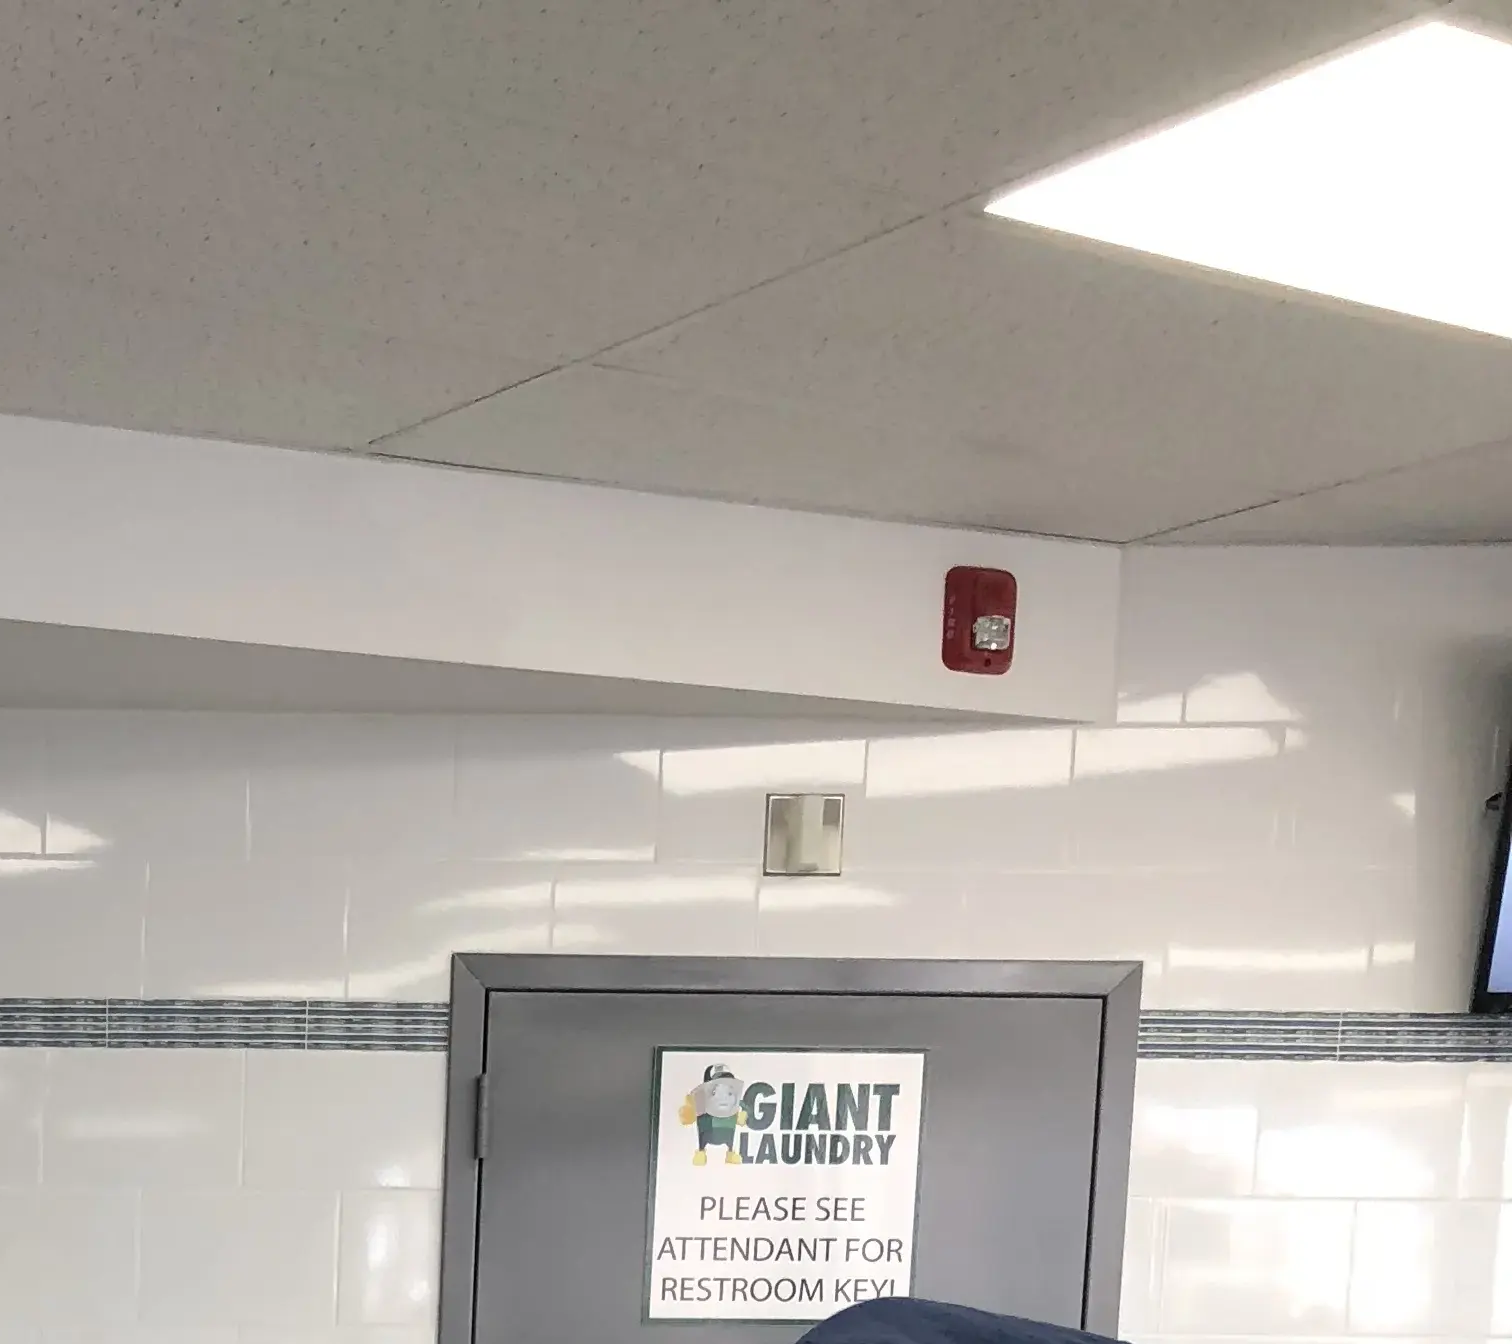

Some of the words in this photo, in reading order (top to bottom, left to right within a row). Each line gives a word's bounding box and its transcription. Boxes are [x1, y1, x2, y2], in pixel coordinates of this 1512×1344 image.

[741, 1081, 901, 1131] GIANT
[739, 1131, 897, 1165] LAUNDRY
[699, 1196, 807, 1222] PLEASE
[814, 1196, 866, 1222] SEE
[656, 1236, 838, 1262] ATTENDANT
[845, 1238, 903, 1263] FOR
[660, 1277, 824, 1303] RESTROOM
